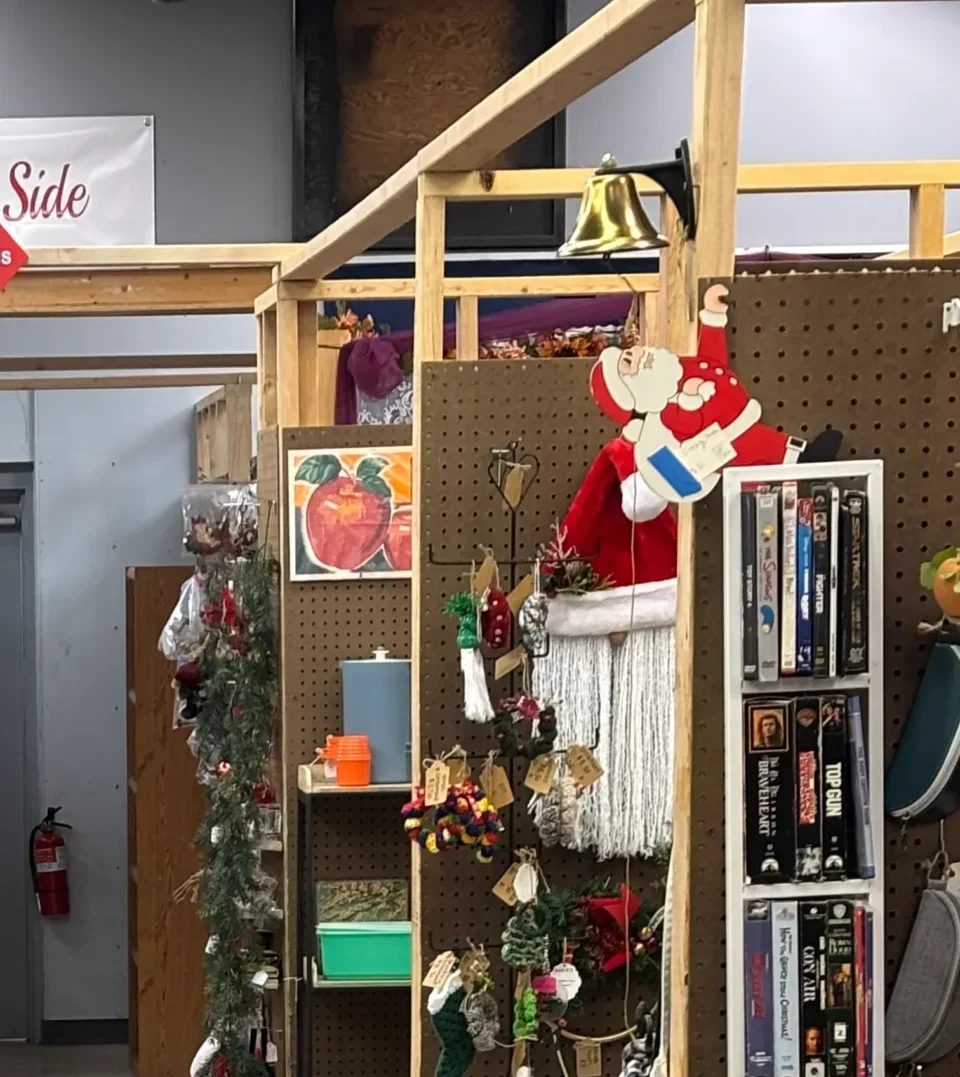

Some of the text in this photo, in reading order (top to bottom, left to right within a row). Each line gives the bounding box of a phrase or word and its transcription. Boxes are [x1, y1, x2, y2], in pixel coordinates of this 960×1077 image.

[2, 160, 90, 224] Side
[851, 516, 861, 590] STAR TREK
[815, 574, 824, 614] FIGHTER
[758, 760, 770, 836] BRAVEHEART
[825, 762, 842, 818] TOP GUN
[803, 946, 816, 1003] CON AIR
